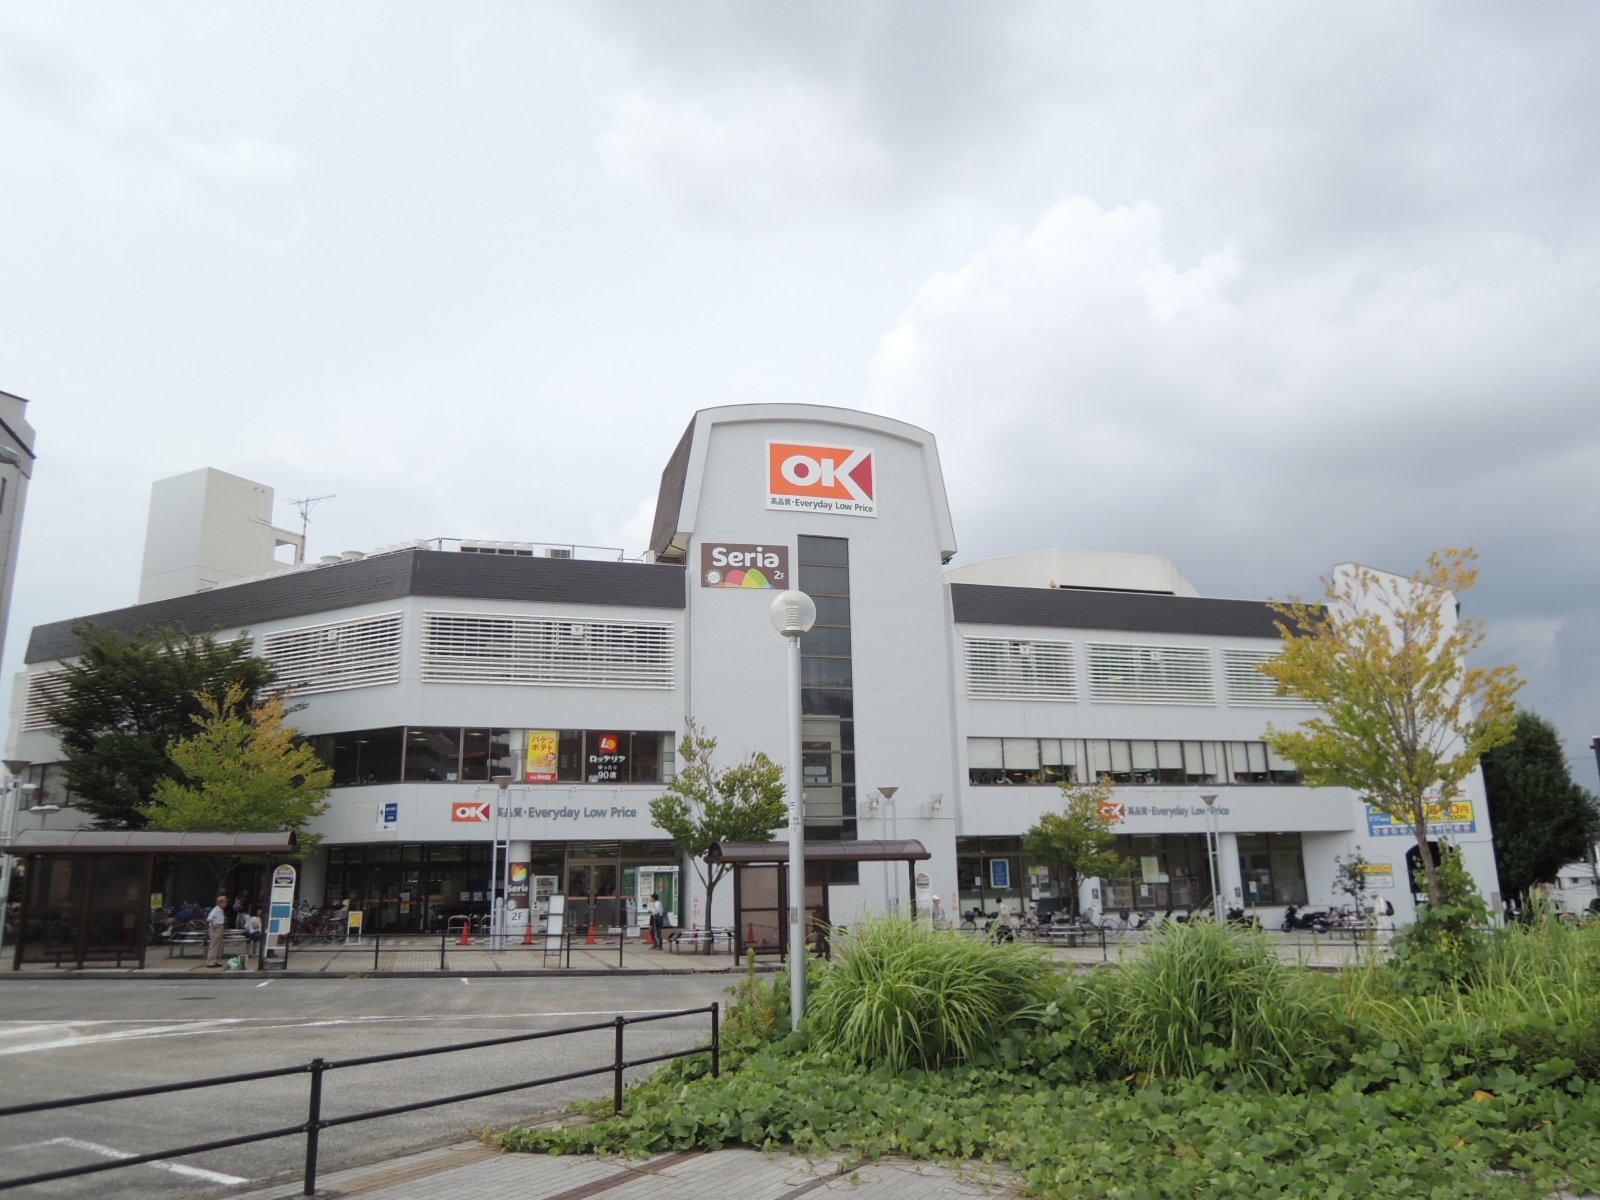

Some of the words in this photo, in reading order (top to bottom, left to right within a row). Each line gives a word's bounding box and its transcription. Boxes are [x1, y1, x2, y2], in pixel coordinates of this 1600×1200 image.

[781, 449, 873, 502] OK
[835, 501, 852, 511] Low
[854, 503, 874, 513] Price
[712, 546, 780, 568] Seria
[773, 570, 785, 580] 2F
[532, 736, 555, 744] バケツ
[531, 744, 554, 752] ポテト
[589, 755, 626, 763] ロッテリア
[455, 803, 490, 822] OK
[583, 806, 607, 818] Low
[610, 806, 637, 818] Price
[507, 884, 529, 892] Seria
[511, 911, 523, 921] 2F
